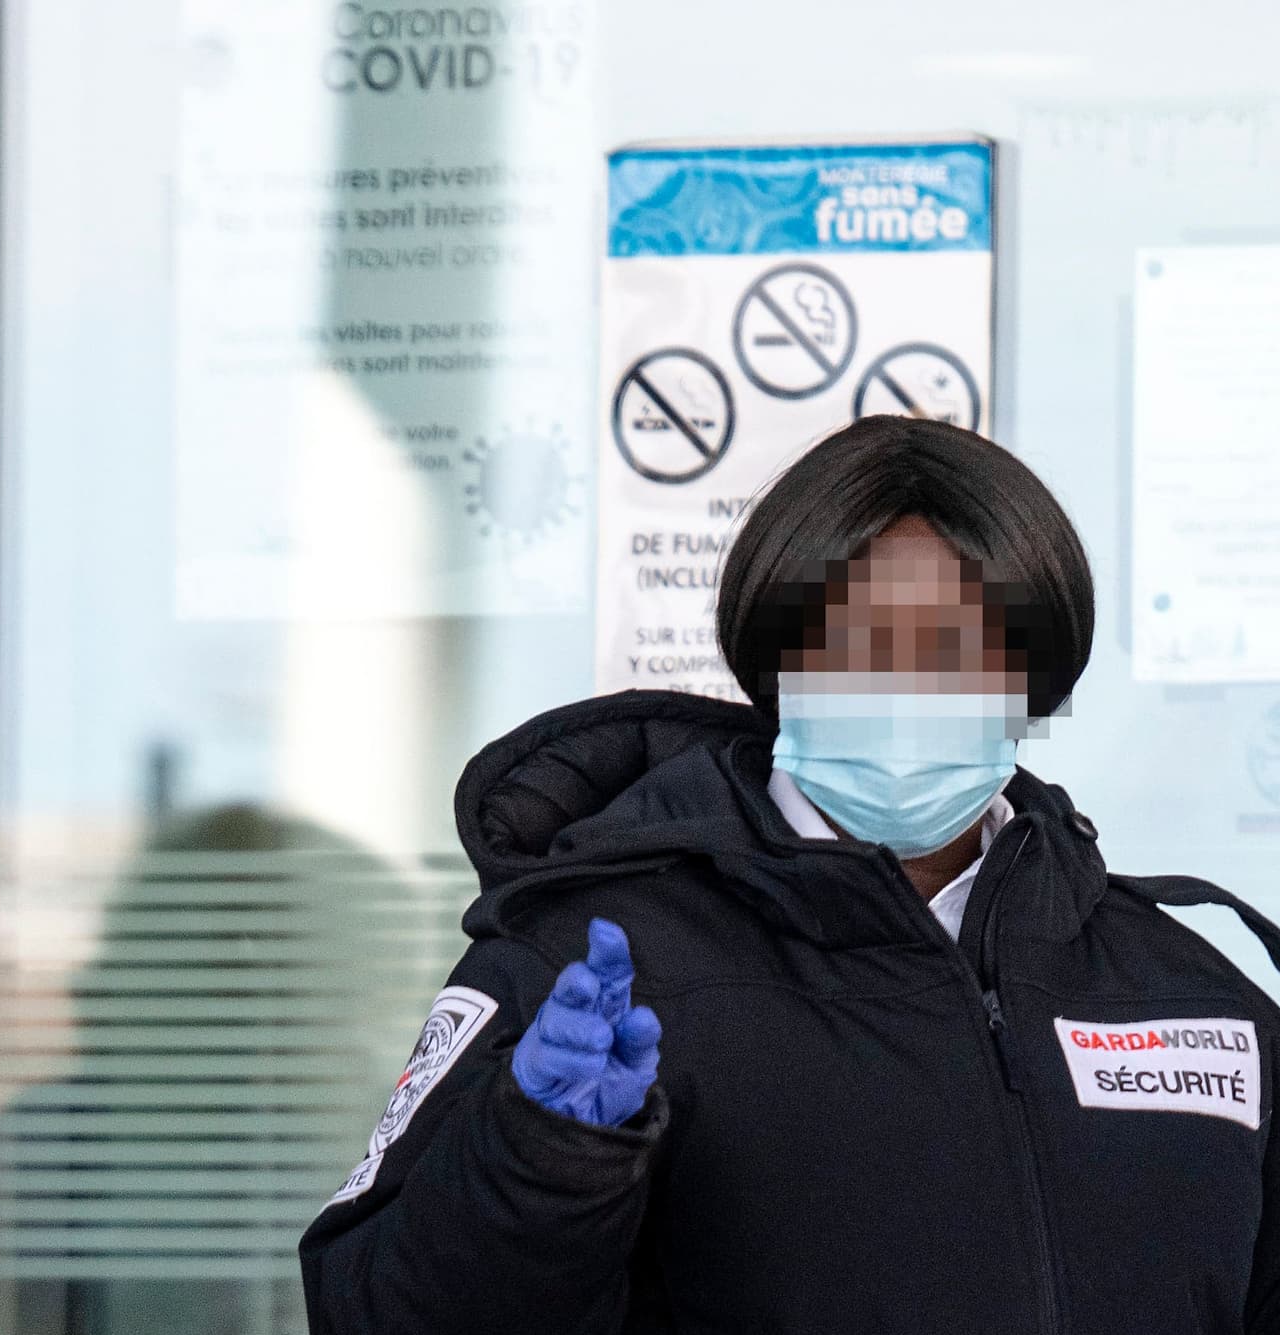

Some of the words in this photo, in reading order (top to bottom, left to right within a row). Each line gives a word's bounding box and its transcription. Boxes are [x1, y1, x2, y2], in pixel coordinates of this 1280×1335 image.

[816, 196, 969, 242] fumée
[709, 498, 748, 519] INT
[632, 532, 663, 555] DE
[673, 532, 730, 555] FUM
[637, 564, 718, 592] (INCLU
[637, 626, 675, 646] SUR
[629, 655, 641, 674] Y
[1070, 1029, 1250, 1053] GARDAWORLD
[1094, 1065, 1247, 1104] SÉCURITÉ
